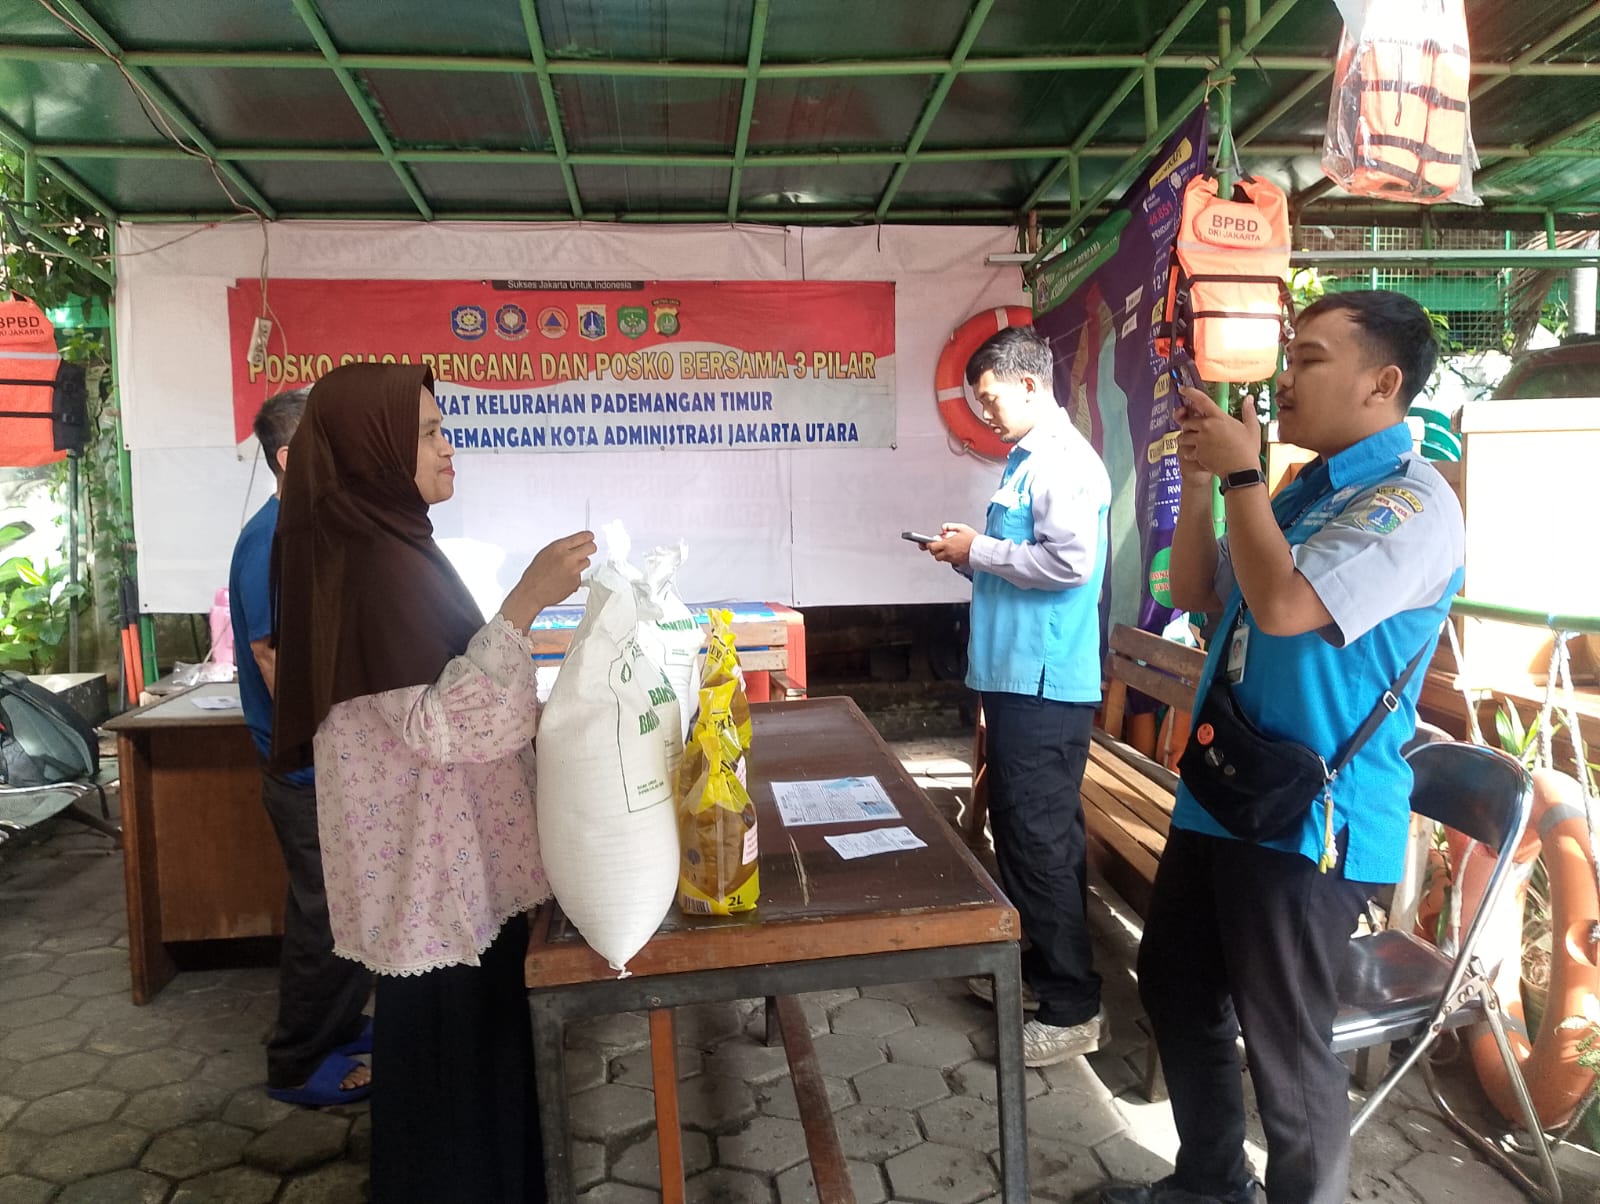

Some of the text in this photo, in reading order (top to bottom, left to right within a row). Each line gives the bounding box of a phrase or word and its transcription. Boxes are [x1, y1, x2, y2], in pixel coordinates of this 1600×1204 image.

[1212, 214, 1258, 233] BPBD
[1208, 229, 1261, 242] DKI JAKARTA
[508, 280, 632, 289] Sukses Jakarta Untuk Indonesia
[248, 353, 333, 383] POSKO
[540, 351, 588, 381] DAN
[596, 351, 674, 380] POSKO
[680, 351, 789, 380] BERSAMA
[793, 351, 807, 379] 3
[812, 351, 876, 379] PILAR
[476, 393, 585, 415] KELURAHAN
[591, 391, 716, 414] PADEMANGAN
[720, 391, 773, 411] TIMUR
[551, 425, 599, 446] KOTA
[603, 423, 723, 446] ADMINISTRASI
[729, 422, 801, 446] JAKARTA
[806, 422, 859, 443] UTARA
[728, 895, 743, 907] 2L
